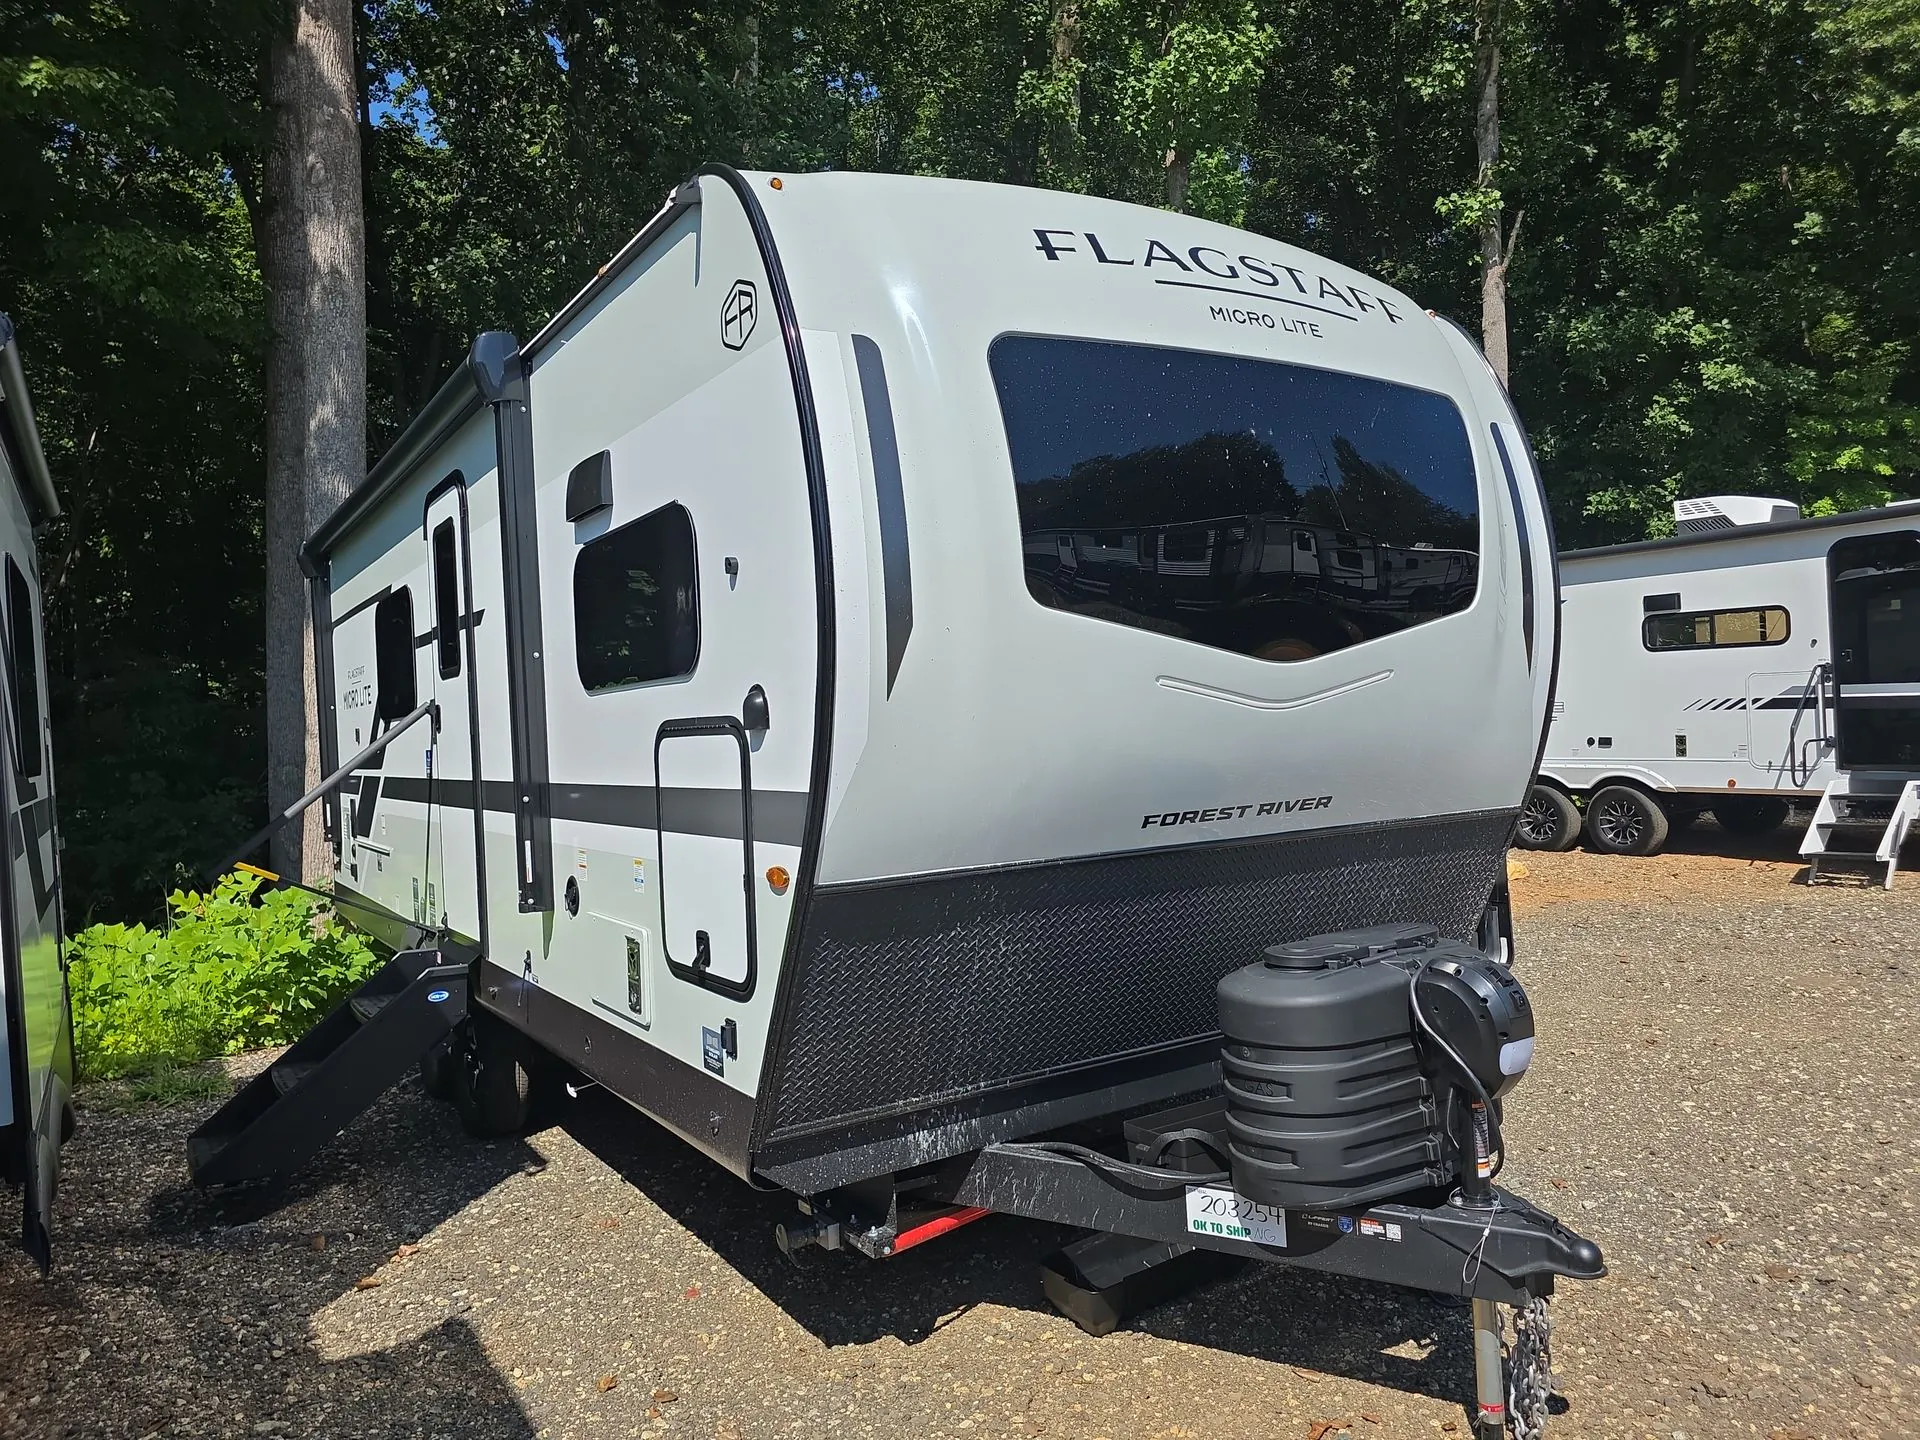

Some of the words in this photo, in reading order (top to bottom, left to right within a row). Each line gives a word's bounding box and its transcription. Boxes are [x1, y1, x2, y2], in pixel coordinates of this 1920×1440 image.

[1032, 228, 1404, 325] FLAGSTAFF
[1209, 305, 1276, 329] MICRO
[1282, 318, 1324, 339] LITE
[343, 688, 359, 710] MICRO
[360, 684, 372, 706] LITE
[1140, 804, 1253, 829] FOREST
[1255, 795, 1334, 817] RIVER
[1244, 1080, 1274, 1097] GAS
[1200, 1194, 1283, 1226] 203254
[1193, 1219, 1208, 1232] OK
[1210, 1221, 1223, 1234] TO
[1226, 1224, 1252, 1238] SHIP
